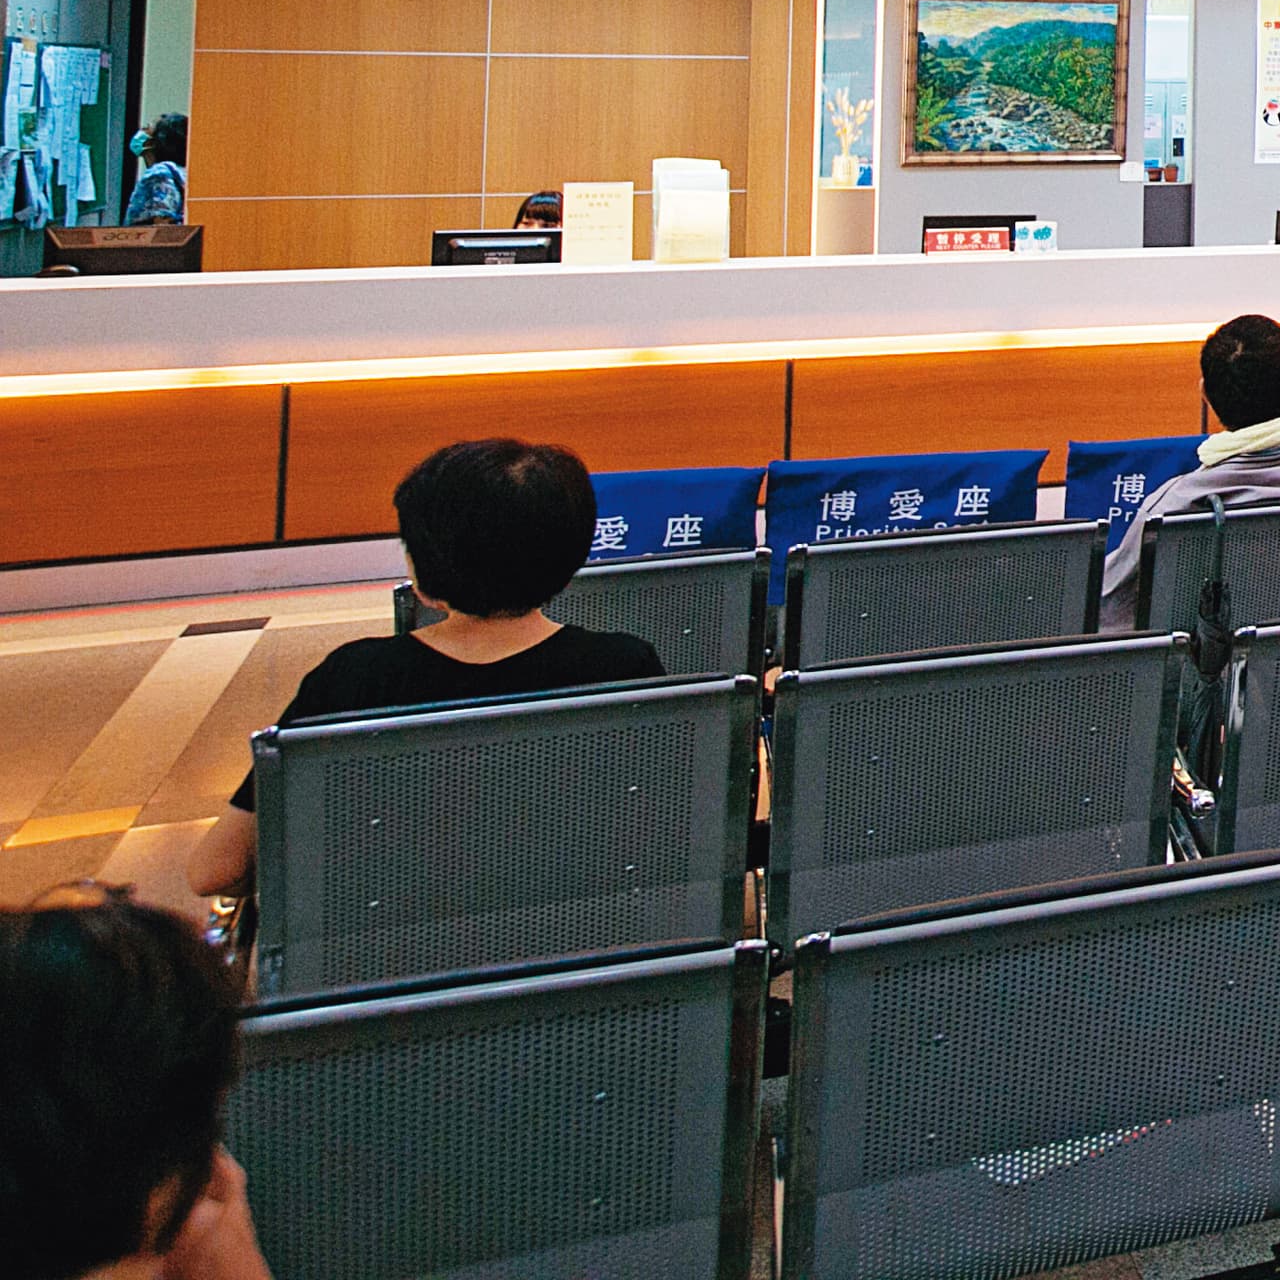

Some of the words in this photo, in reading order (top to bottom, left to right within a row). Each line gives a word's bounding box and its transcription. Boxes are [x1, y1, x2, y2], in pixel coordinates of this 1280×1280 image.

[103, 230, 146, 242] acer
[819, 485, 992, 522] 博愛座
[590, 513, 704, 552] 愛座
